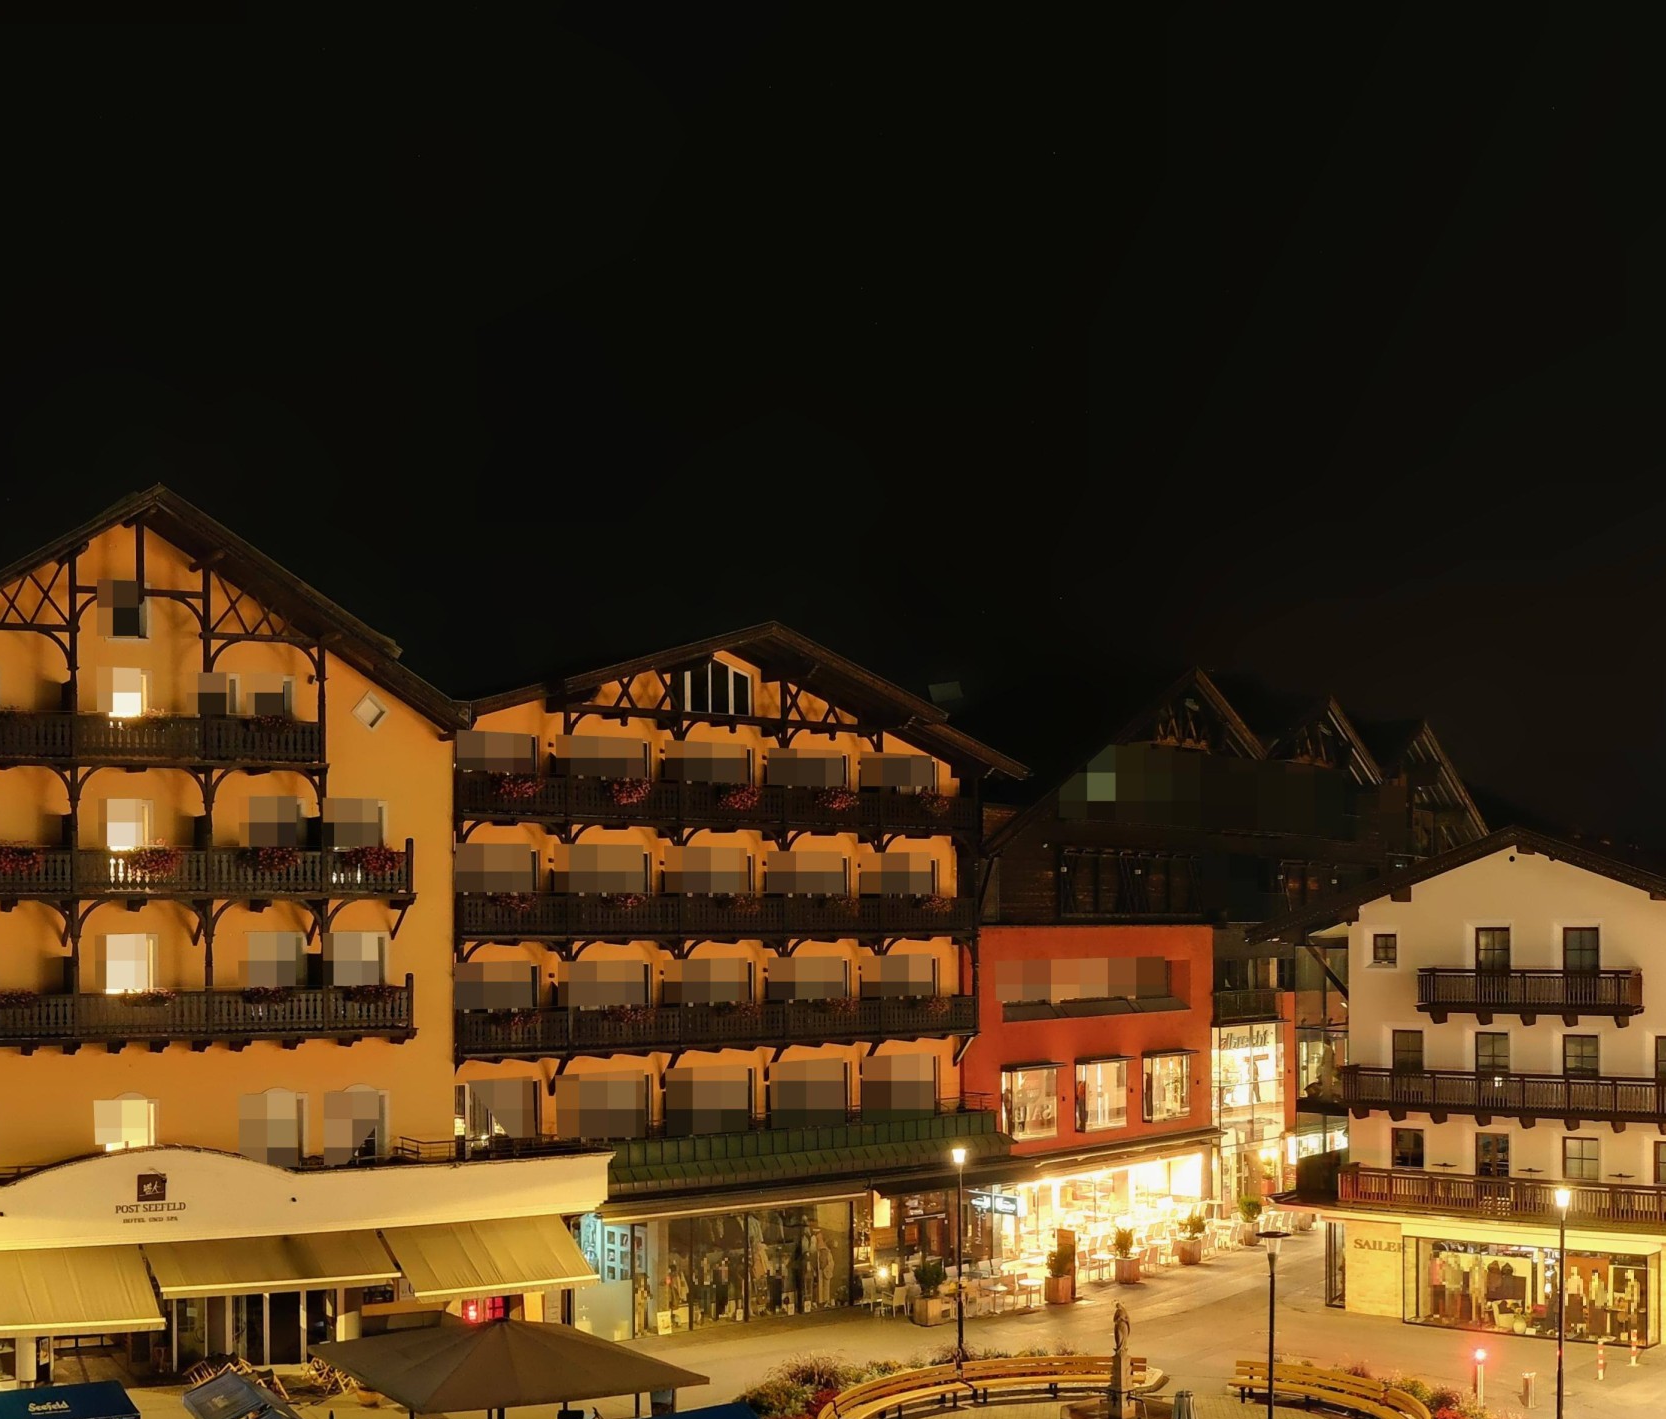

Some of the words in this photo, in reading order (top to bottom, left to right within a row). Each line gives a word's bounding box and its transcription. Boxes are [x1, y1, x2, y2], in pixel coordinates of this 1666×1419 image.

[115, 1204, 141, 1214] POST
[142, 1202, 186, 1213] SEEFELD
[27, 1400, 70, 1412] Seefeld
